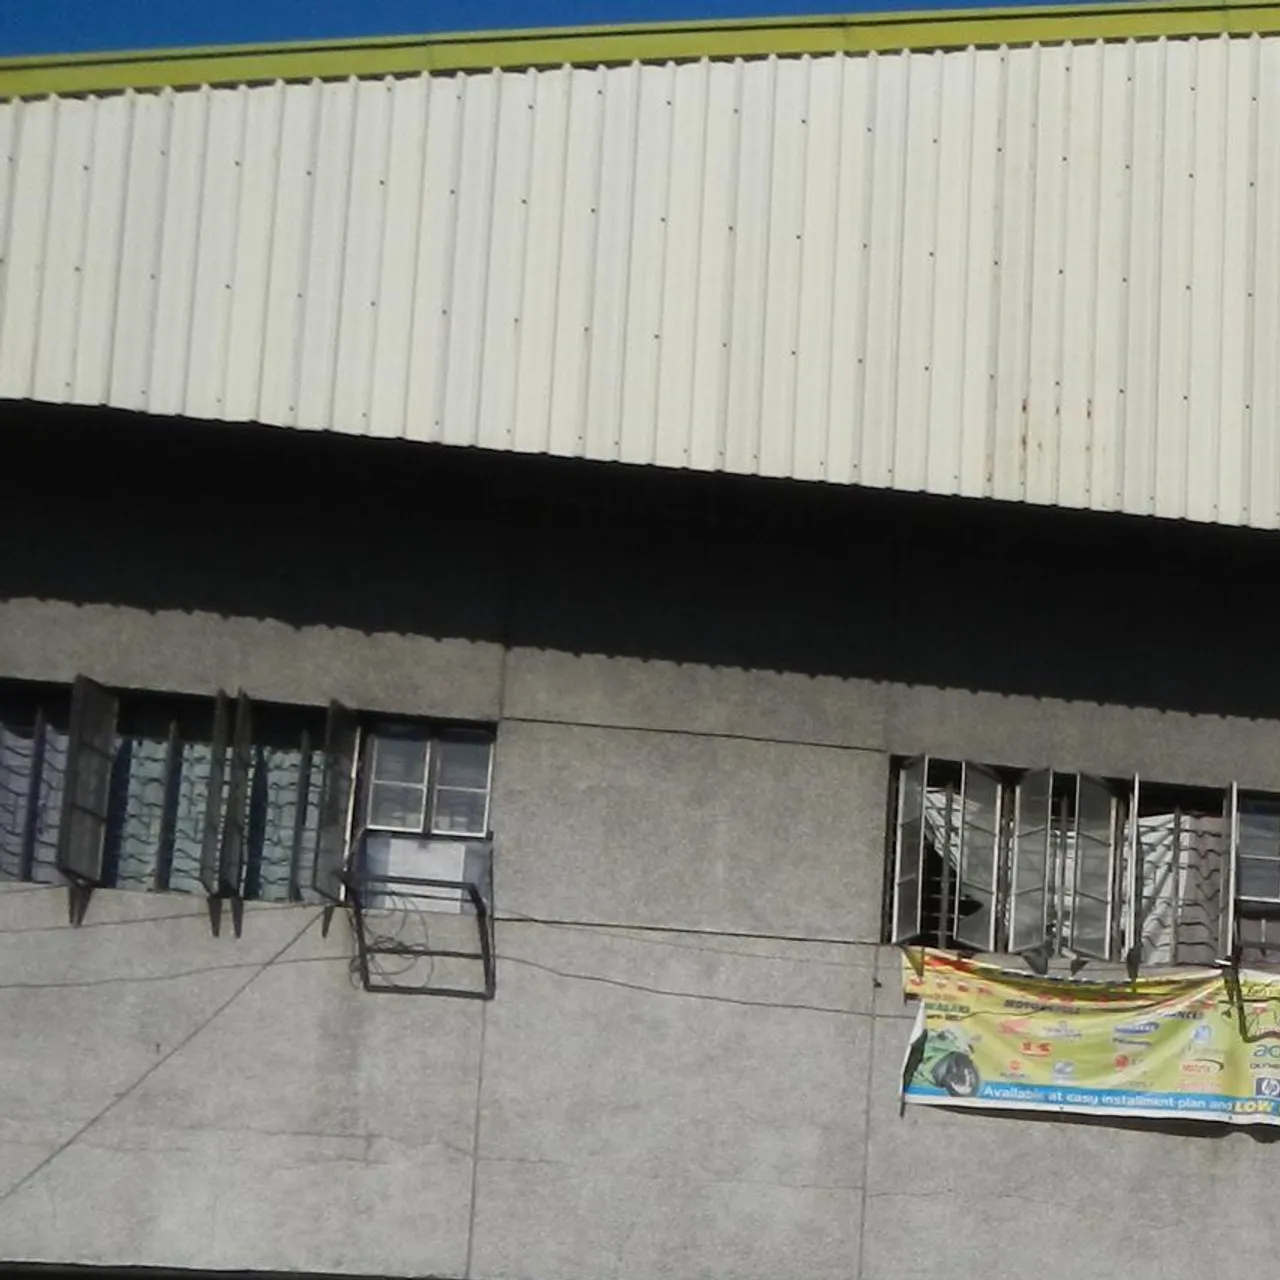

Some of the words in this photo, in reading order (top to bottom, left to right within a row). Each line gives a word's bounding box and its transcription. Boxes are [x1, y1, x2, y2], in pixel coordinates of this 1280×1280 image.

[1066, 1093, 1098, 1106] easy
[1102, 1093, 1175, 1107] installment
[1178, 1096, 1206, 1110] plan
[1234, 1100, 1273, 1114] LOW
